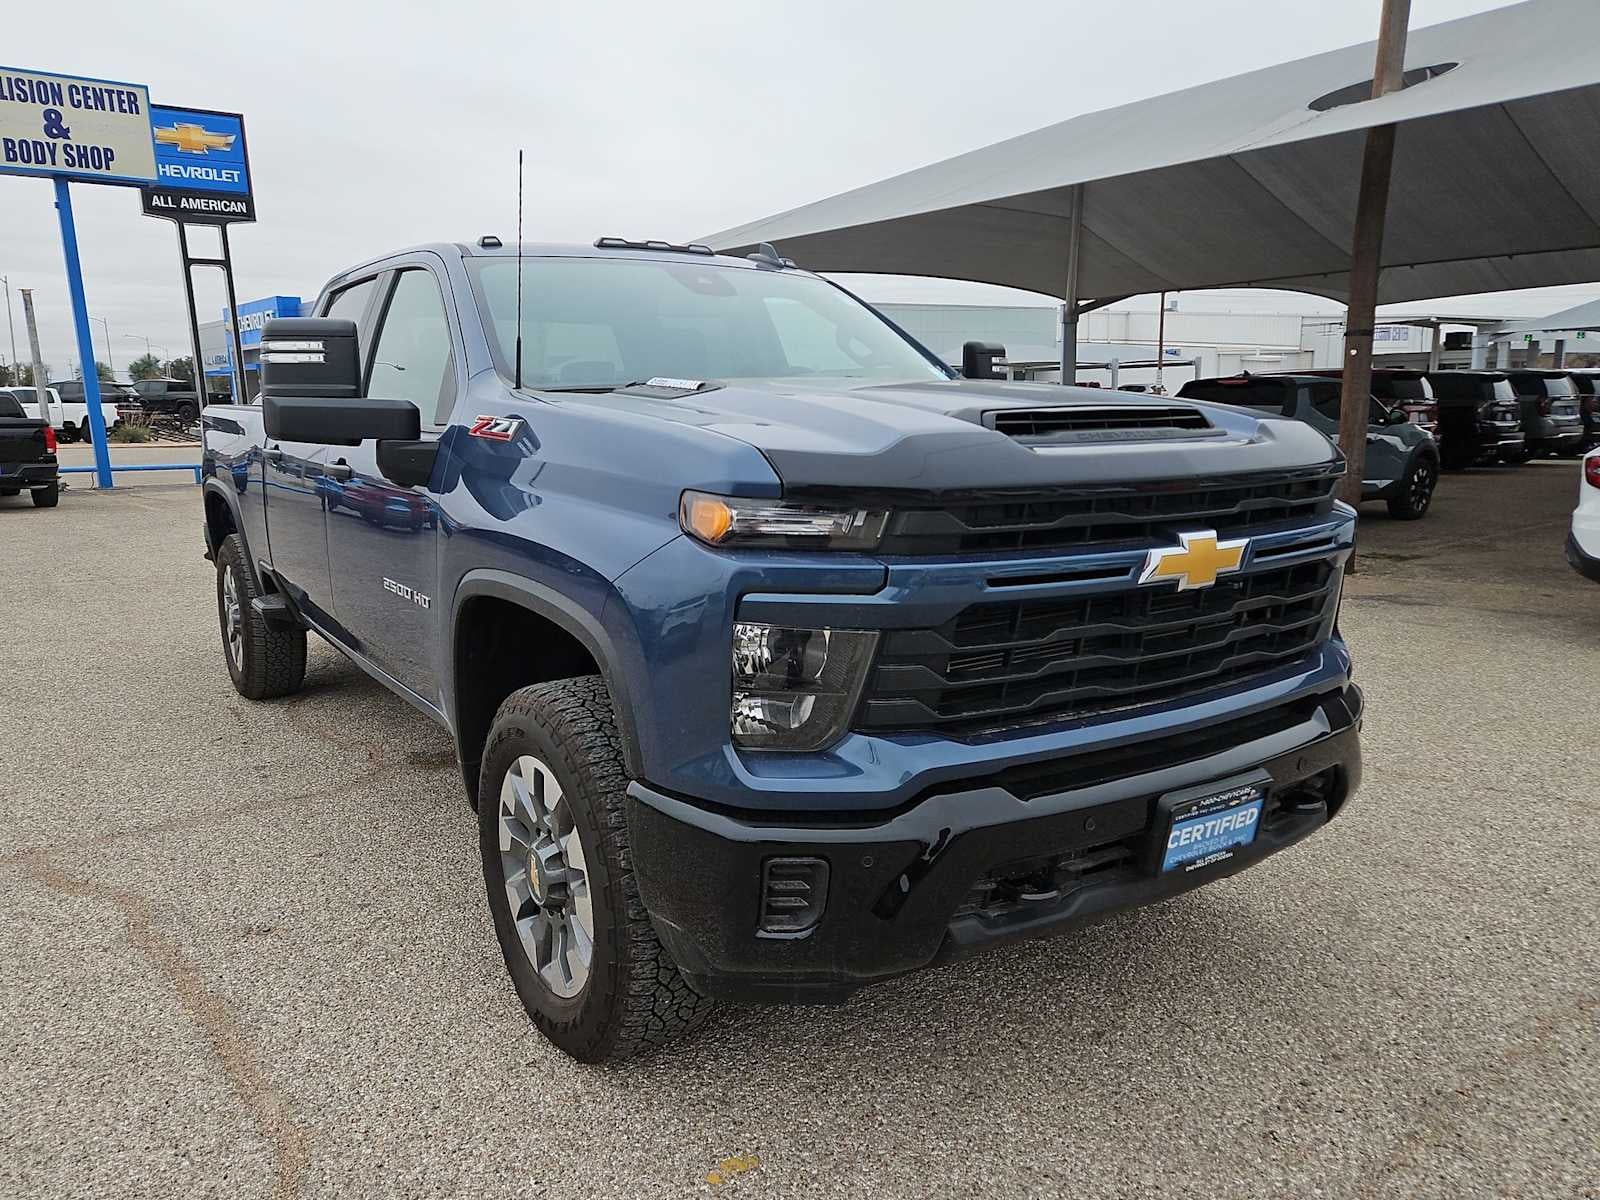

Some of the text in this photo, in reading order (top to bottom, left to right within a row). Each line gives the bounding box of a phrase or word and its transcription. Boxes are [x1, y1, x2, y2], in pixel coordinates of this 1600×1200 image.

[68, 84, 140, 115] CENTER
[43, 108, 72, 140] &
[3, 137, 115, 171] BODY SHOP
[151, 195, 247, 213] ALL AMERICAN
[468, 414, 524, 441] Z71
[383, 576, 431, 609] 2500 HD
[1167, 807, 1258, 849] CERTIFIED
